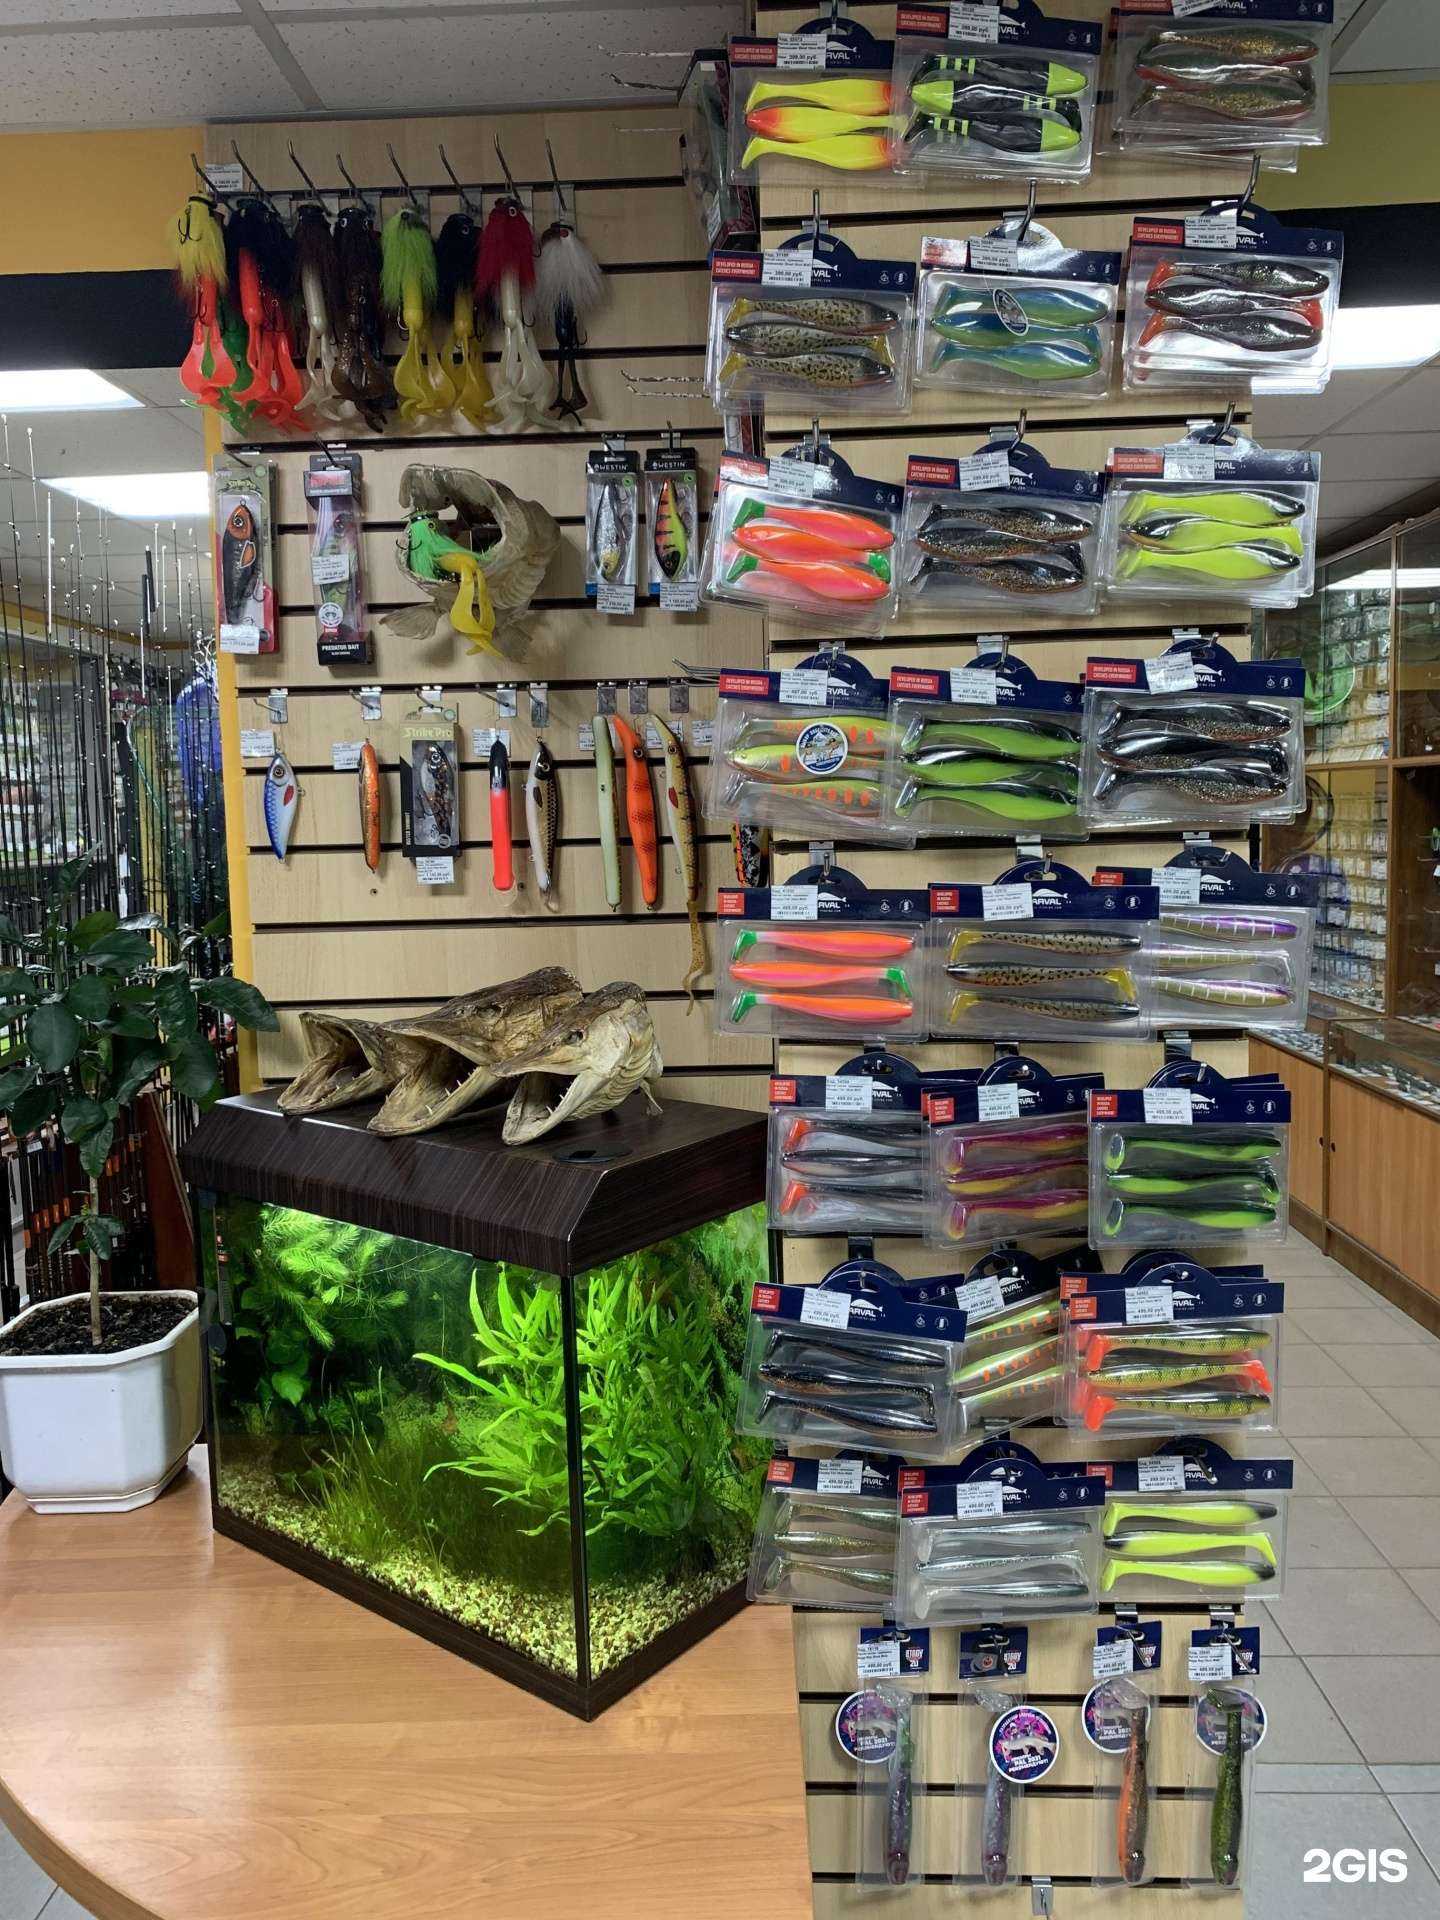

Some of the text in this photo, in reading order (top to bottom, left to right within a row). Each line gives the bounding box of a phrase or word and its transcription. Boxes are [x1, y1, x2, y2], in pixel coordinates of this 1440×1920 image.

[403, 727, 453, 738] Strike Pro
[818, 901, 840, 909] RVAL
